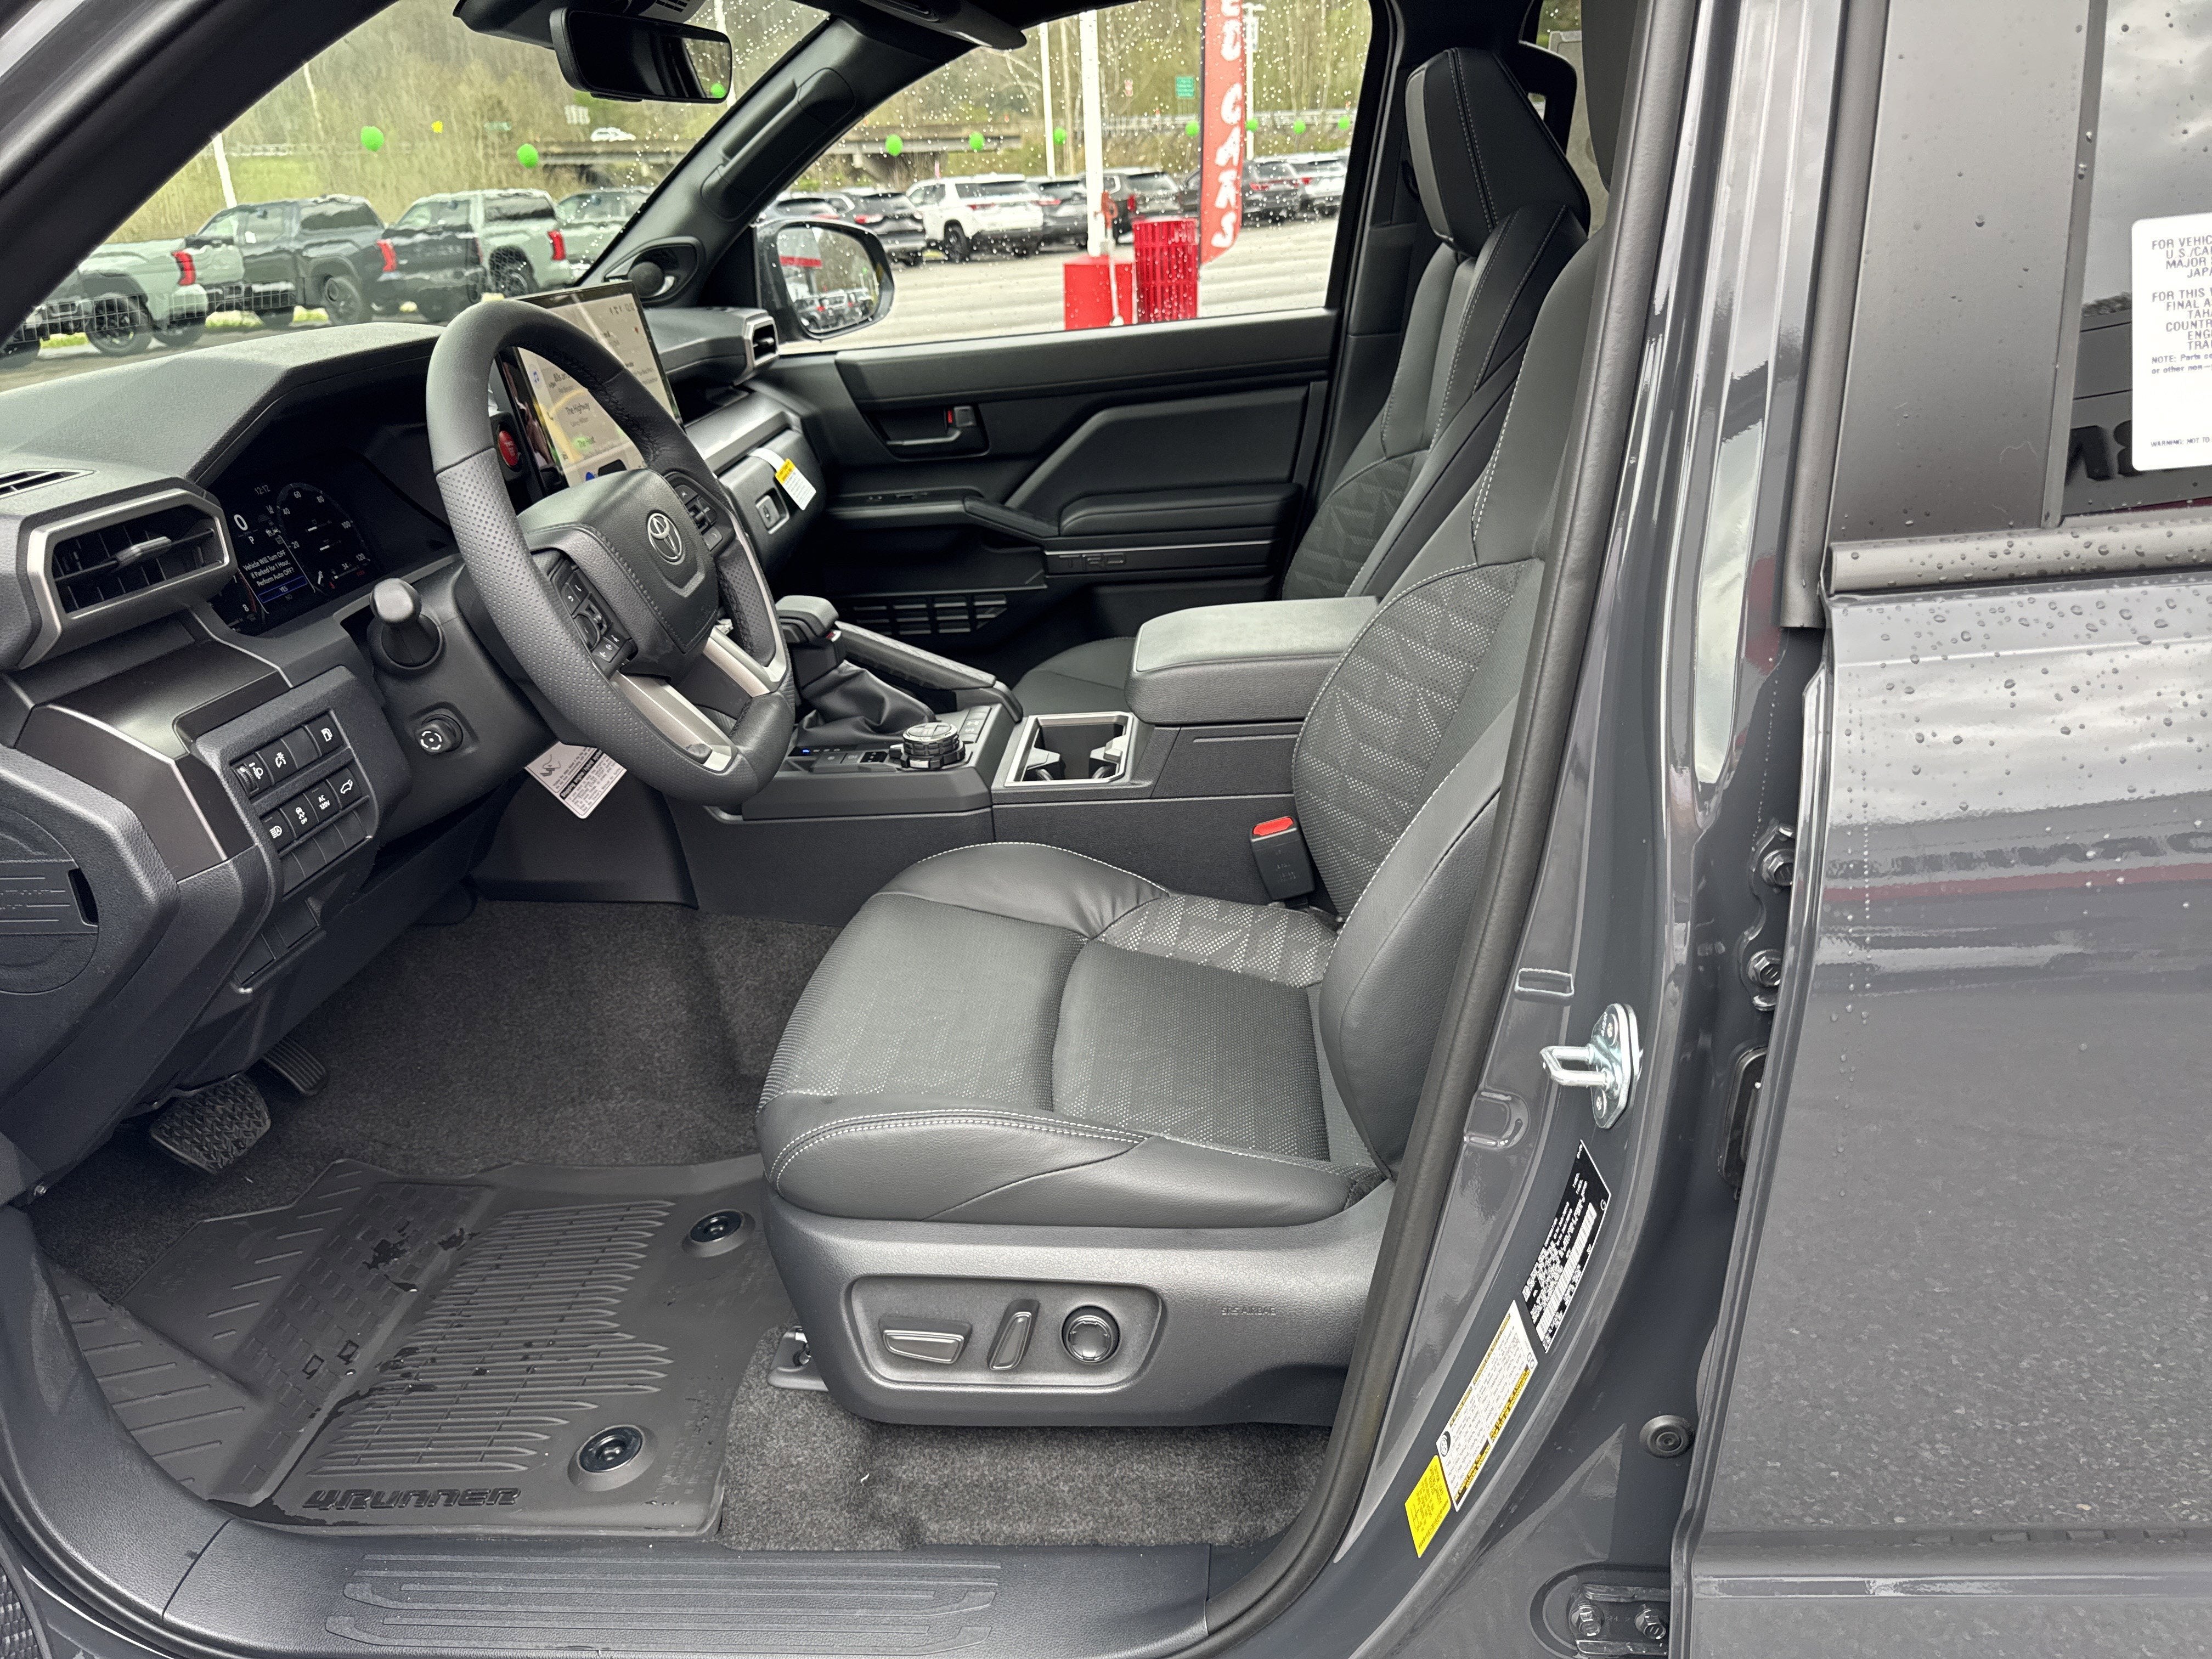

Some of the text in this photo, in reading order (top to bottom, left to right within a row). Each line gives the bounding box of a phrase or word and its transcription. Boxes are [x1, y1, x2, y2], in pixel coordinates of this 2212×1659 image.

[1211, 82, 1243, 247] CARS
[2152, 234, 2212, 250] FOR VEHIC
[2166, 246, 2212, 259] U.S./CA
[2166, 257, 2206, 269] MAJOR
[2152, 287, 2205, 302] FOR THIS
[2166, 300, 2199, 311] FINAL
[2187, 309, 2212, 319] TAH
[2152, 355, 2176, 364] NOTE:
[2180, 353, 2200, 362] Parts
[234, 514, 248, 531] 0
[249, 535, 254, 544] P
[242, 561, 260, 571] Vehicle
[1059, 552, 1126, 569] TRD
[254, 568, 270, 577] Parked
[256, 578, 274, 587] Perform
[319, 800, 330, 810] 120V
[302, 1487, 521, 1510] 4RUNNER
